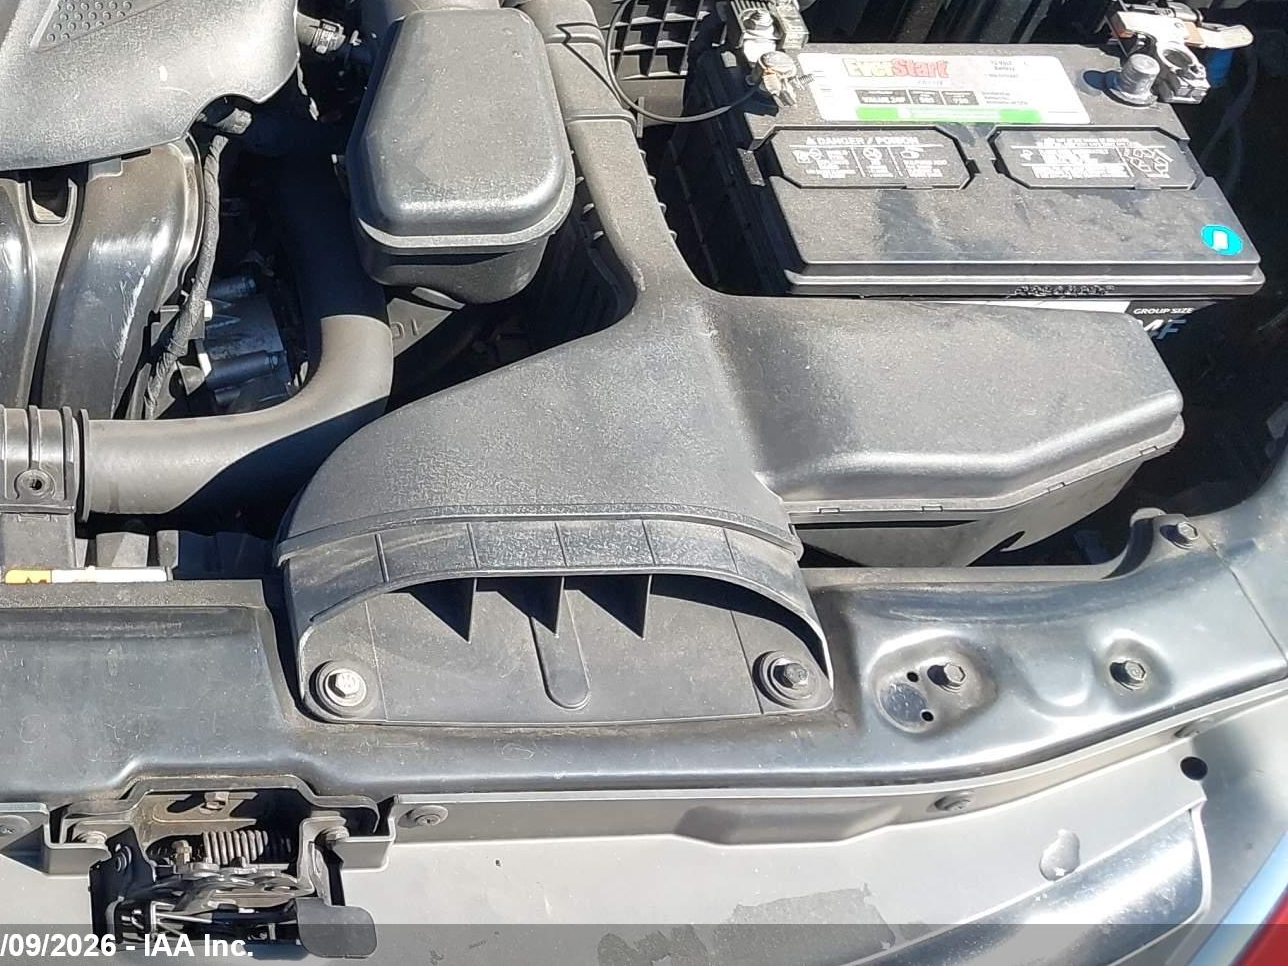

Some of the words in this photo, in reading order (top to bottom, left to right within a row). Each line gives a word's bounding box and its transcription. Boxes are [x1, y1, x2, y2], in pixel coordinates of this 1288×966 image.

[843, 58, 950, 78] EverStart
[816, 136, 865, 145] DANGER
[875, 136, 920, 145] POISON
[1133, 307, 1171, 315] GROUP
[1170, 307, 1195, 315] SIZE
